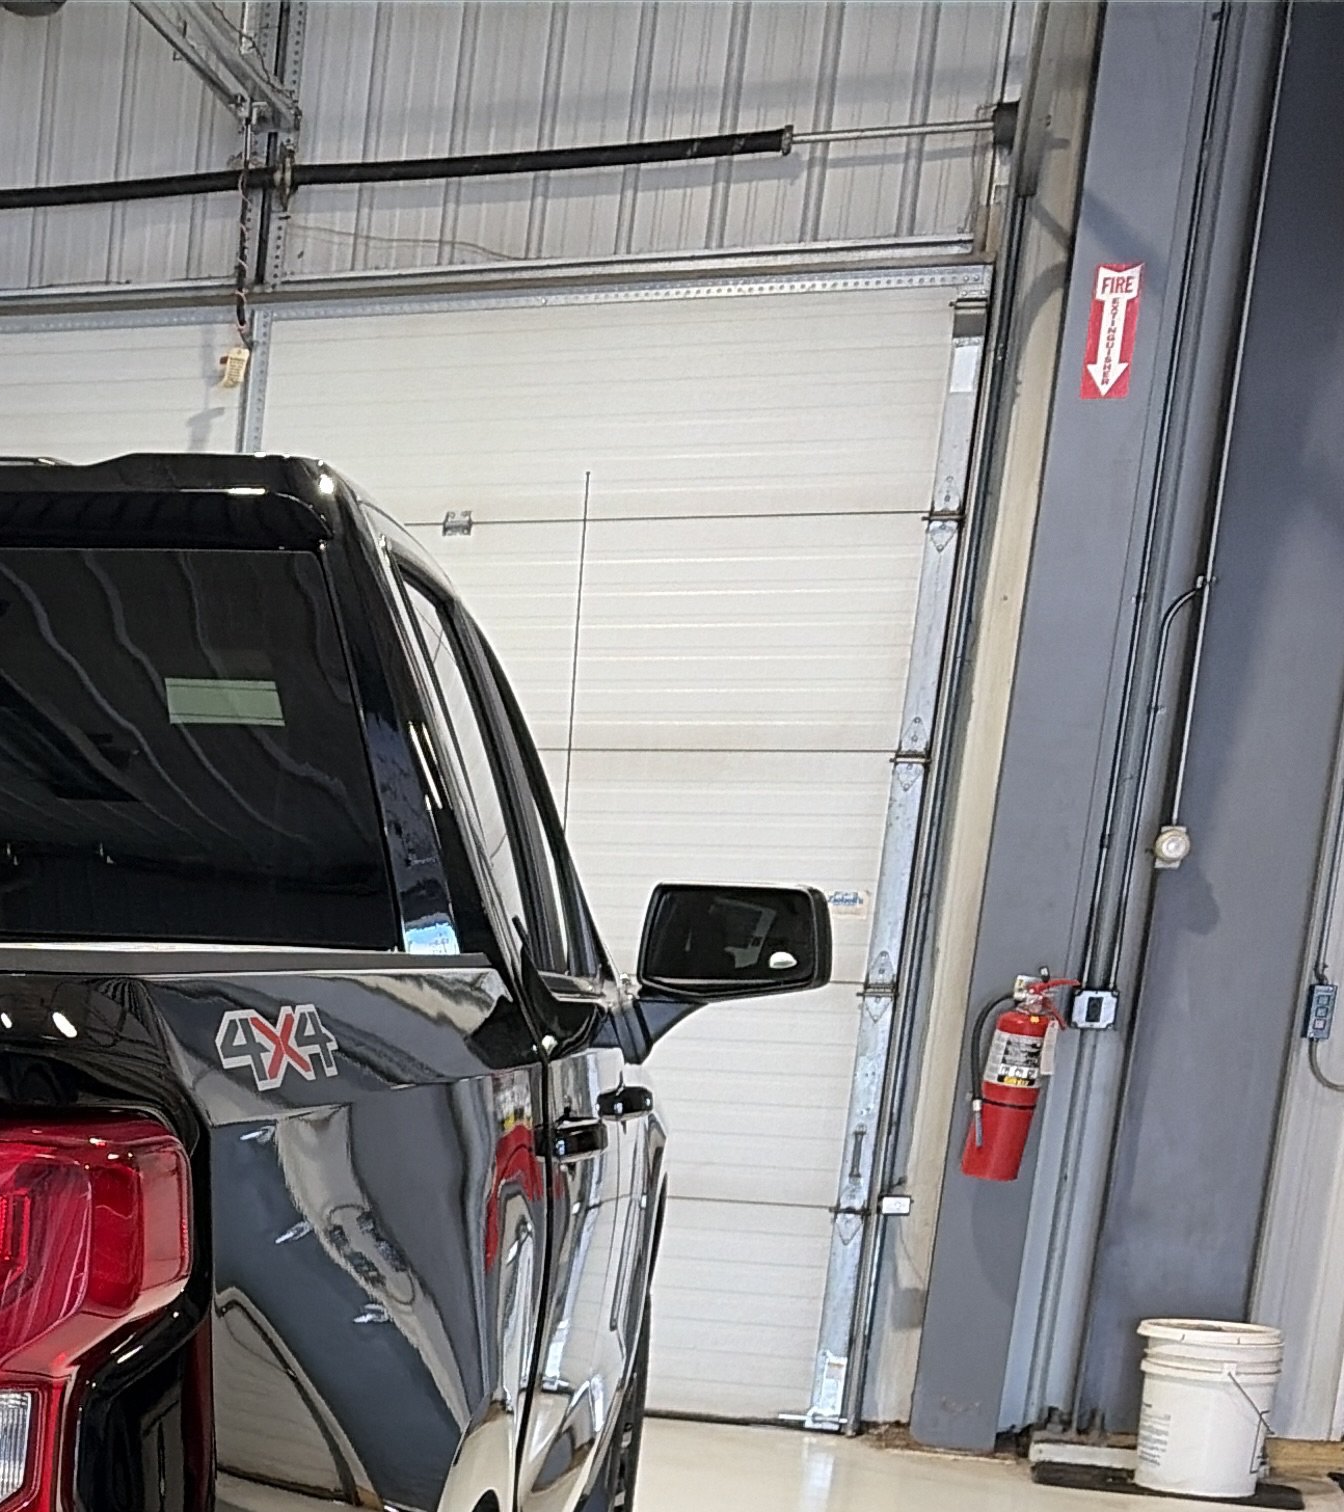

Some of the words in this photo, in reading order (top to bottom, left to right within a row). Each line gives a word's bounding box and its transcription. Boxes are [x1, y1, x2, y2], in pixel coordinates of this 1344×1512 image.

[1101, 276, 1135, 294] FIRE
[1100, 297, 1121, 386] EXTINGUISHER
[215, 1004, 339, 1091] 4X4
